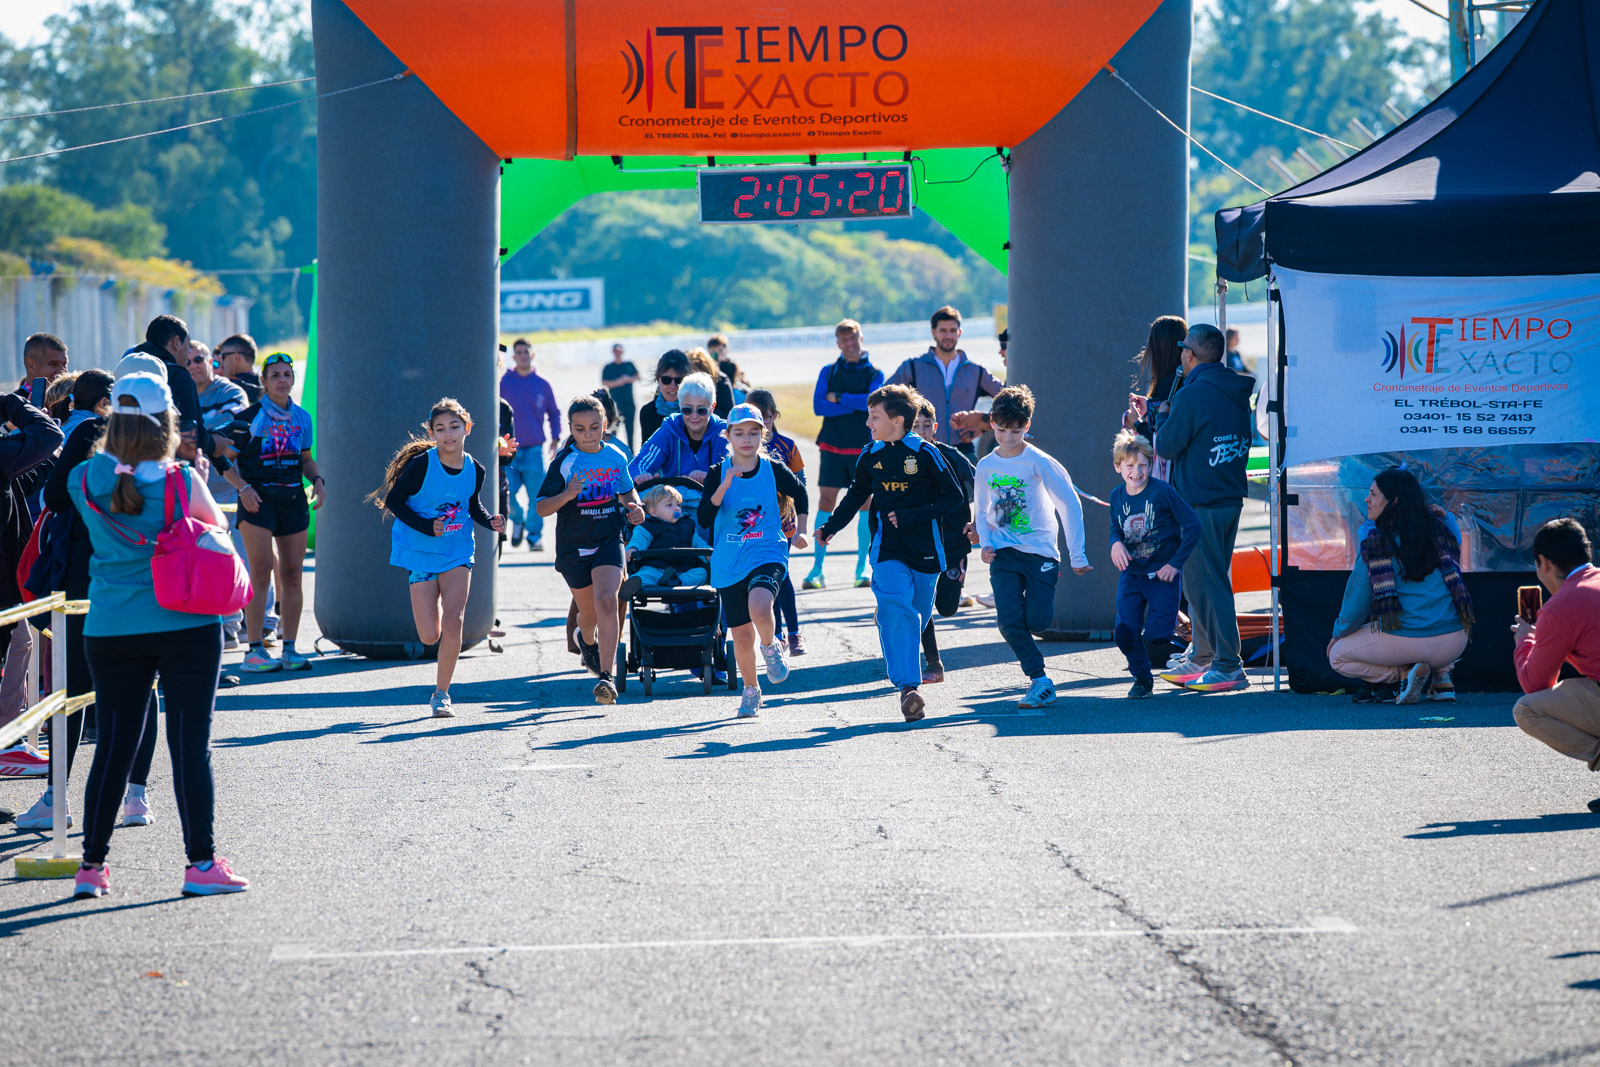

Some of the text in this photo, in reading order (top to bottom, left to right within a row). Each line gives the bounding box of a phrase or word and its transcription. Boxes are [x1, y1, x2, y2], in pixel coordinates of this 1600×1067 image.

[618, 112, 908, 128] Cronometraje de Eventos Deportivos
[734, 171, 904, 218] 2:05:20
[1373, 382, 1569, 394] Cronometraje de Eventos Deportivos
[1394, 399, 1414, 407] EL
[1403, 412, 1533, 422] 03401- 15 52 7413
[1400, 425, 1536, 435] 0341- 15 68 66557
[881, 481, 909, 492] YPF
